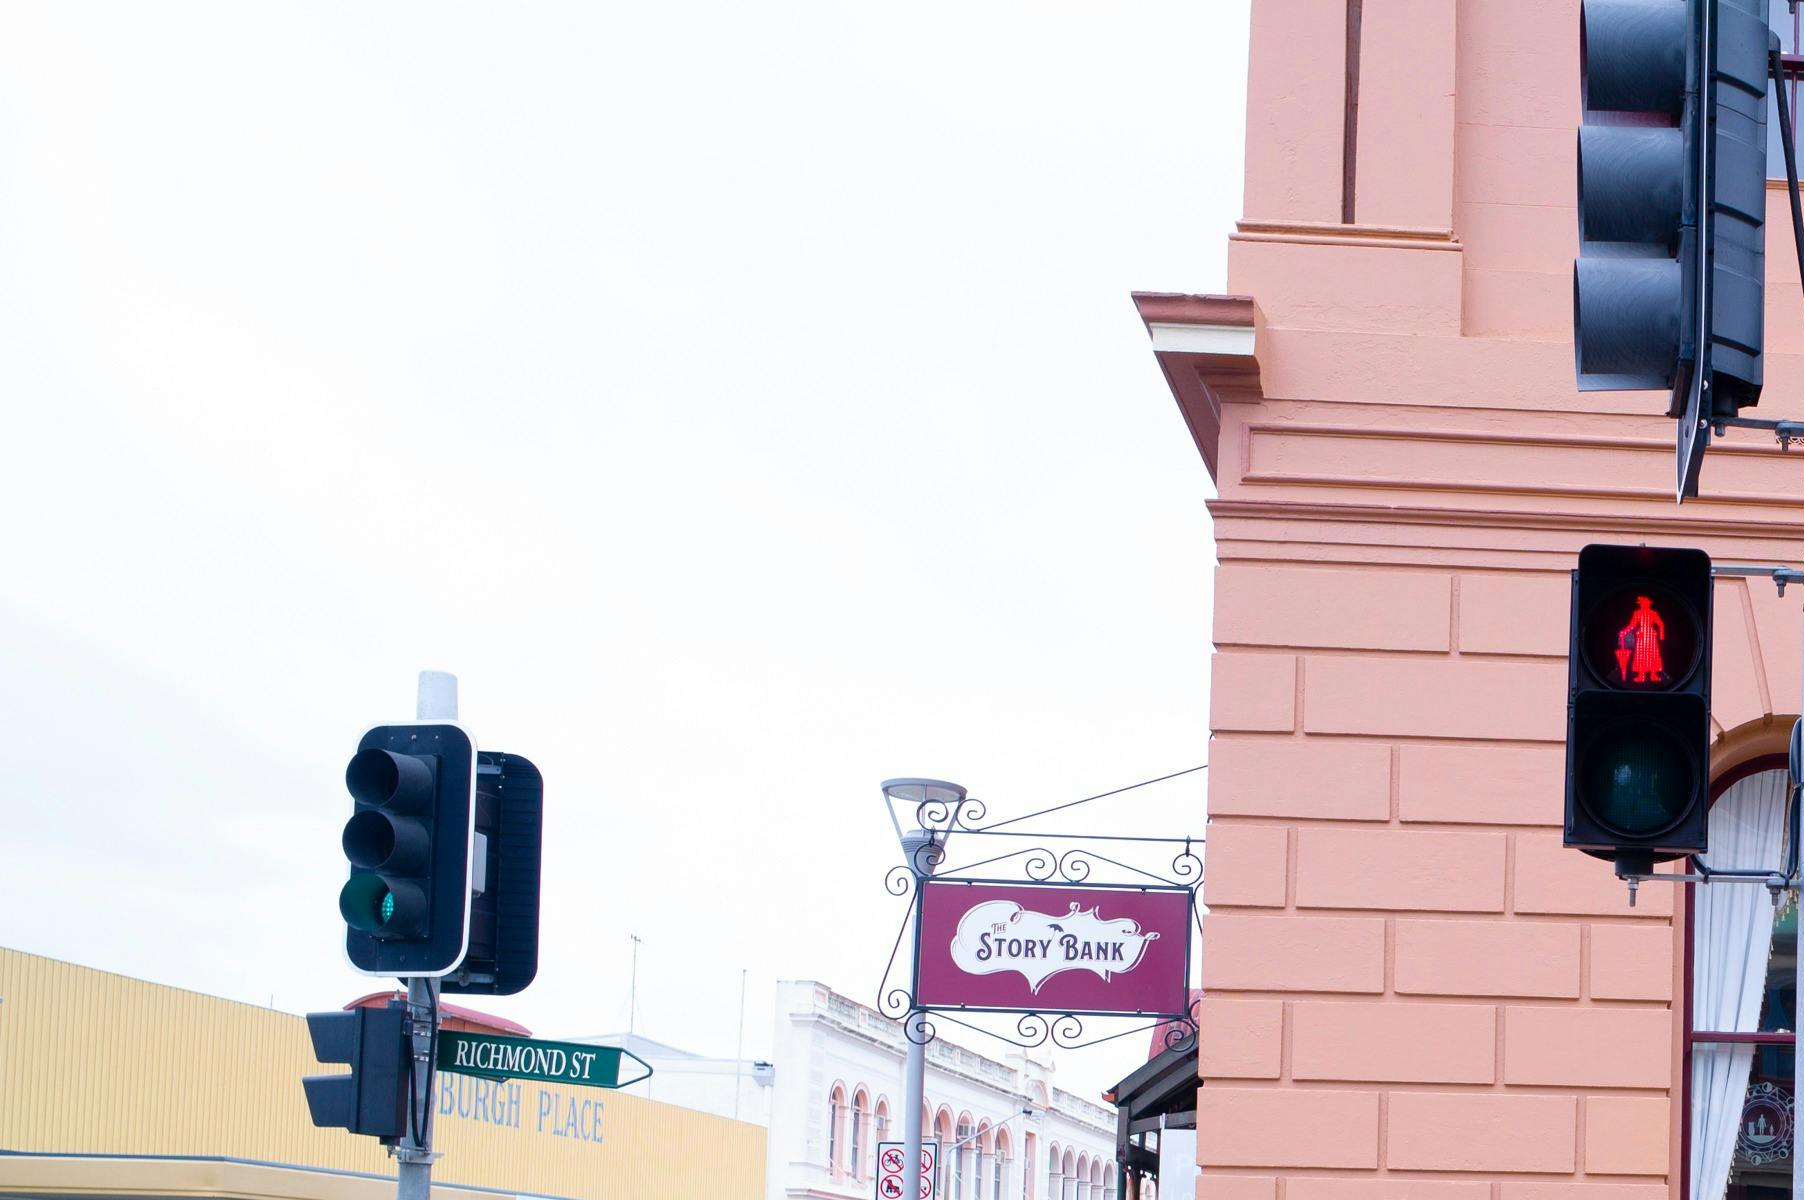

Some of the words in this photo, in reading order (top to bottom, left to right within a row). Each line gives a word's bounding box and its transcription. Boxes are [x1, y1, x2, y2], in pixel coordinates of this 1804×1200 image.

[991, 923, 1007, 934] THE
[976, 932, 1052, 961] STORY
[1060, 934, 1125, 961] BANK
[453, 1040, 567, 1077] RICHMOND
[570, 1051, 596, 1079] ST
[537, 1090, 605, 1144] PLACE
